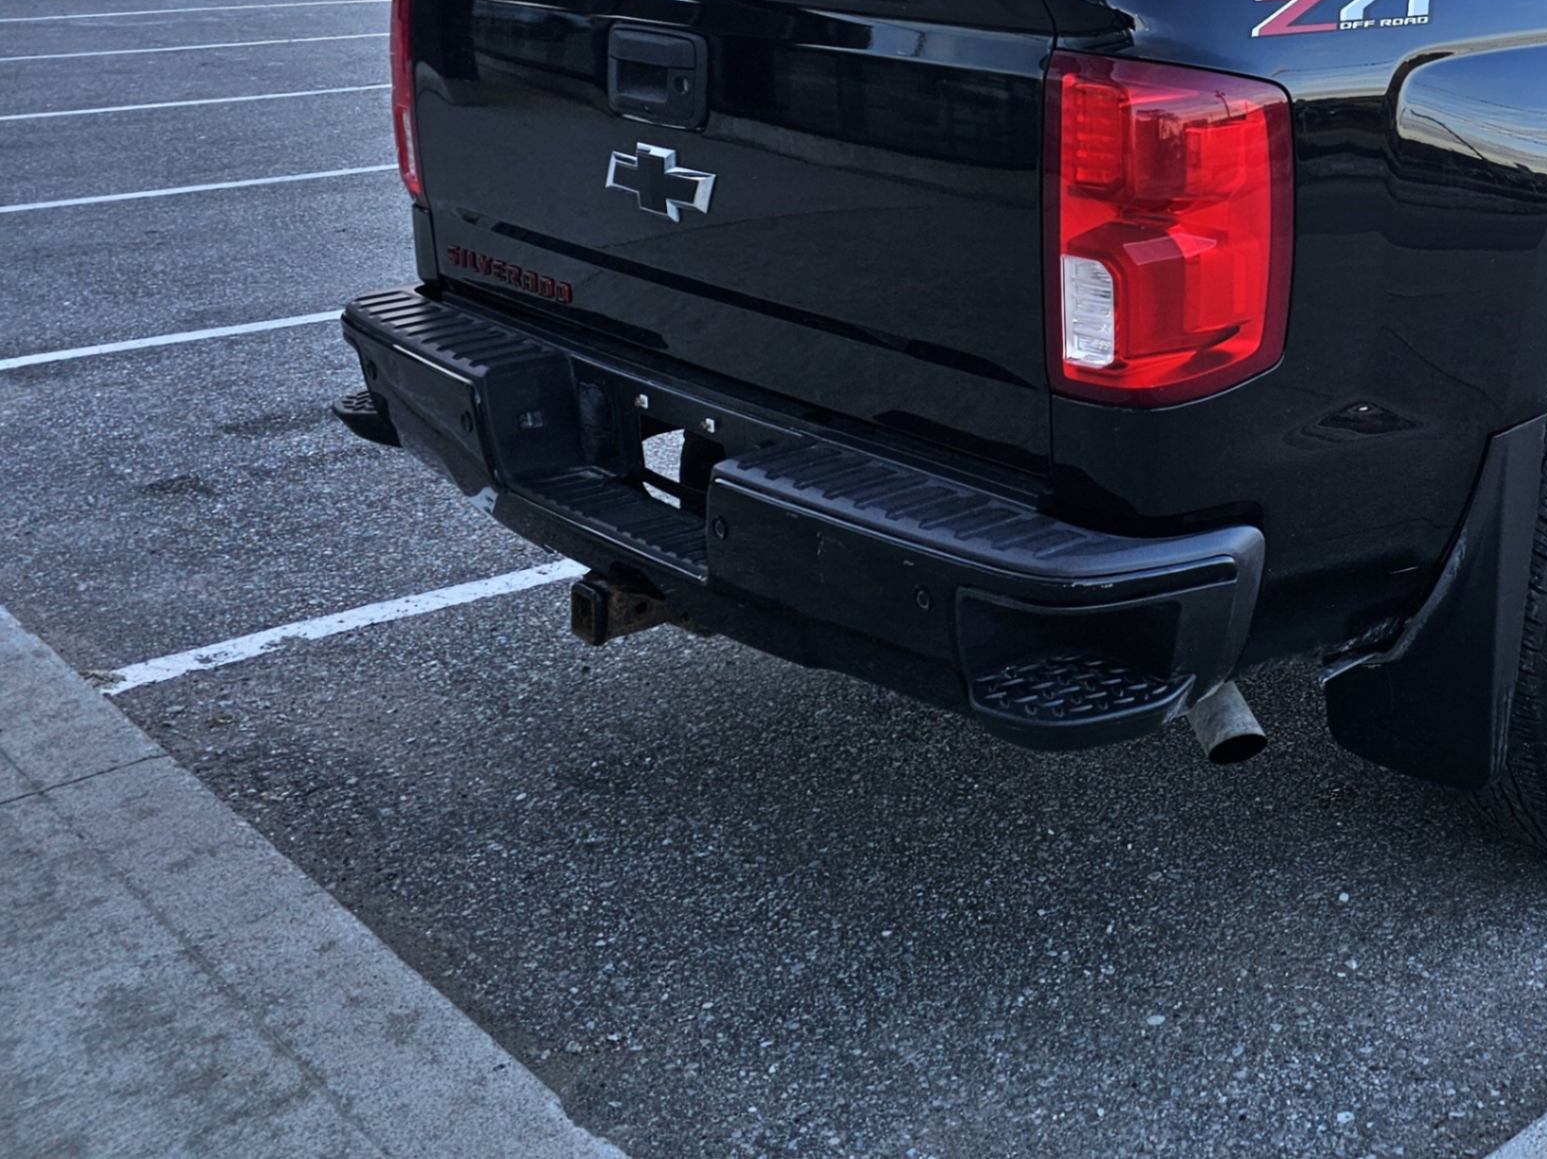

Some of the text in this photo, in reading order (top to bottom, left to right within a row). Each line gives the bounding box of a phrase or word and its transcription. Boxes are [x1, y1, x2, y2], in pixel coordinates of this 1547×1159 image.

[1339, 16, 1429, 31] OFF ROAD
[447, 244, 573, 305] SILVERADO
